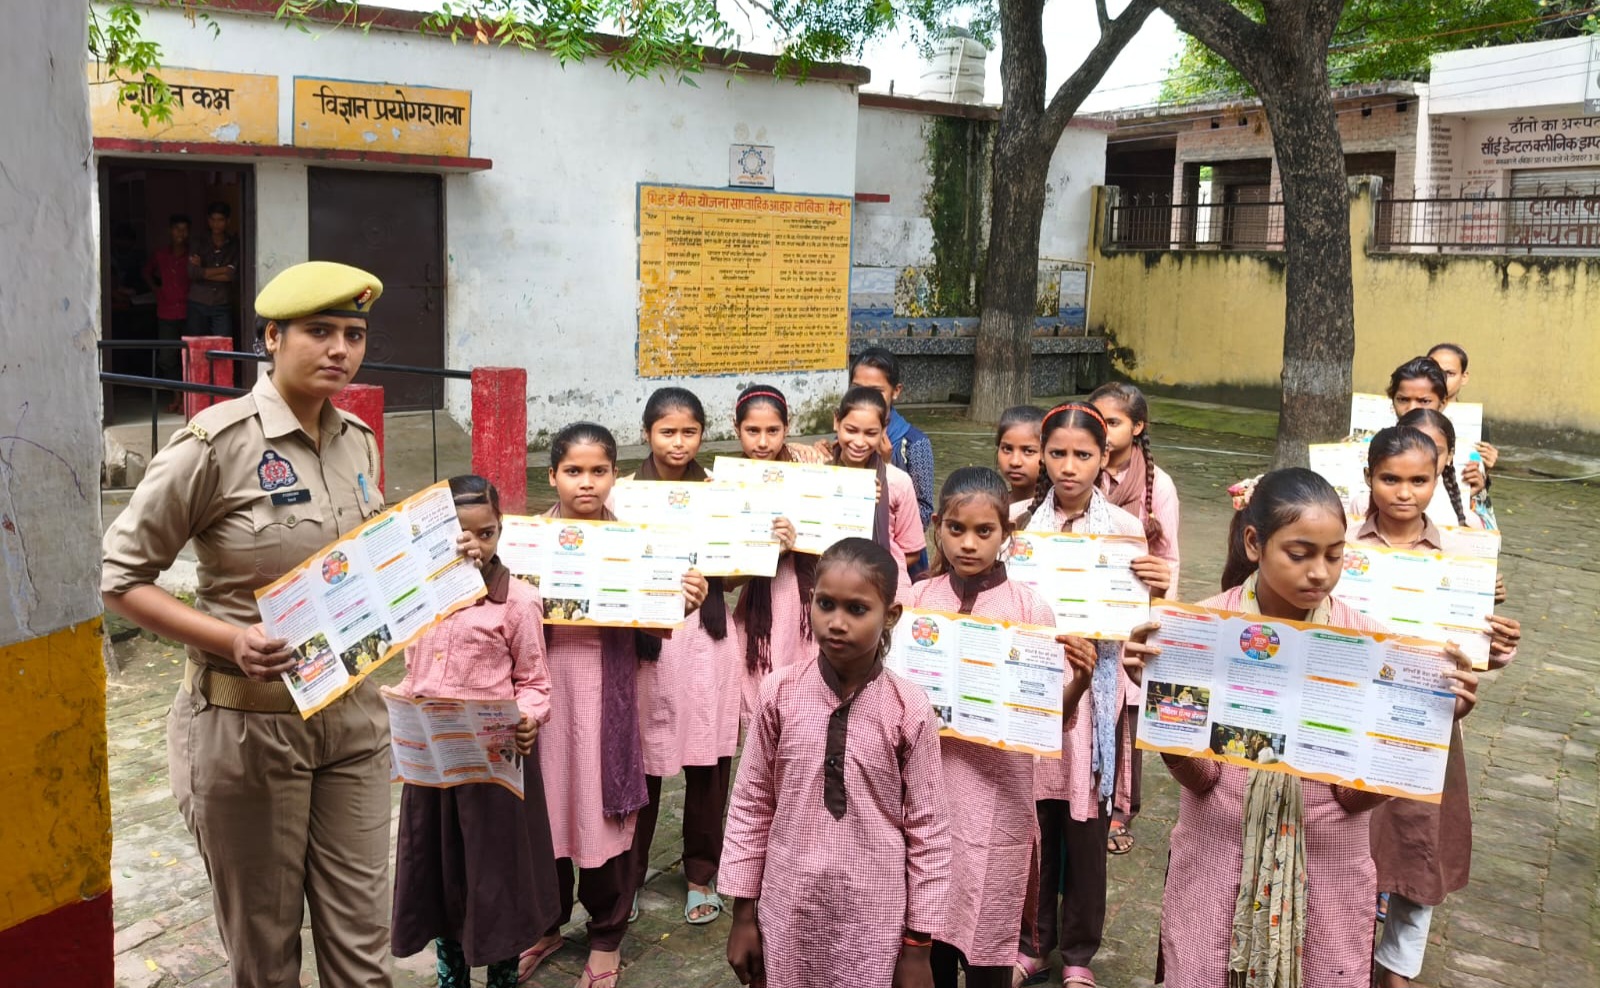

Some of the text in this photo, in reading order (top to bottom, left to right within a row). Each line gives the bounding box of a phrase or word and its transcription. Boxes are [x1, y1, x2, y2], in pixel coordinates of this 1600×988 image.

[188, 85, 235, 111] कक्ष
[312, 84, 465, 126] विज्ञान प्रयोगशाला
[1541, 118, 1559, 131] का
[1533, 133, 1577, 152] क्लीनिक
[678, 191, 696, 207] मील
[698, 192, 728, 209] योजना
[769, 200, 792, 214] आहार
[794, 199, 825, 213] तालिका
